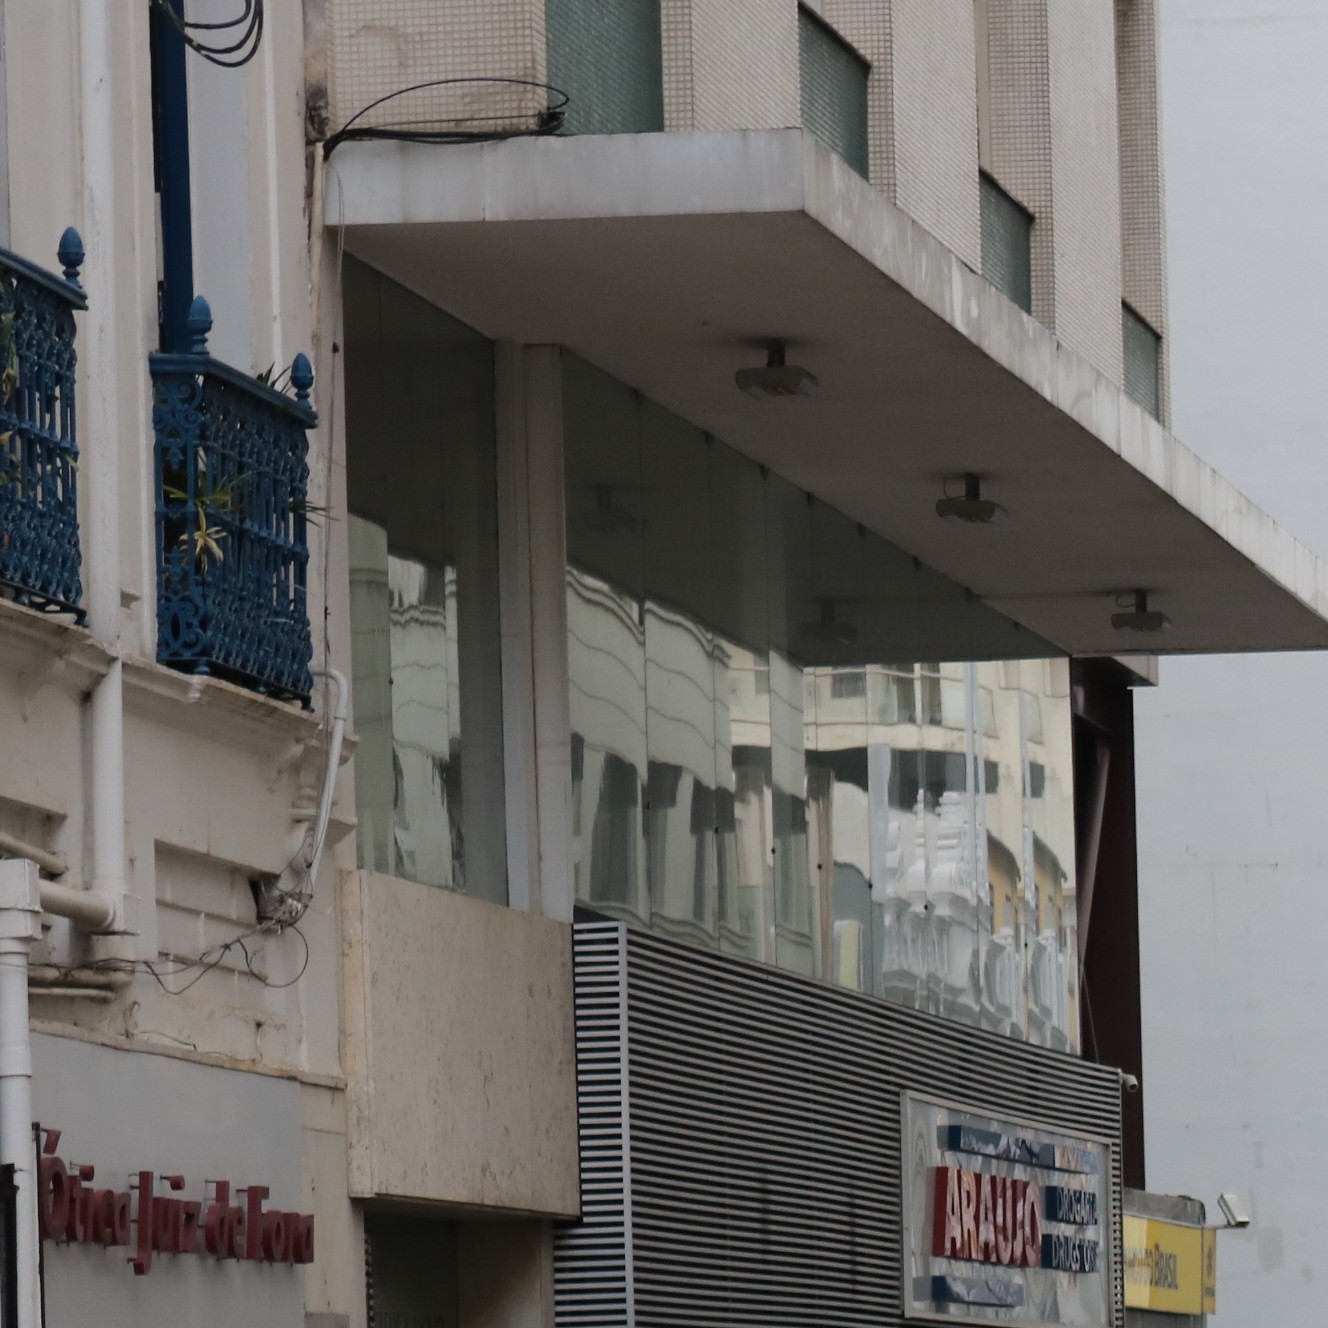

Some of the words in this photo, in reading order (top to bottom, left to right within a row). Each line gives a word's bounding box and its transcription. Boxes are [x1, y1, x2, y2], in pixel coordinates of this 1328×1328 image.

[41, 1129, 131, 1246] Ótica
[132, 1171, 202, 1275] Juiz
[206, 1180, 247, 1259] de
[247, 1186, 314, 1264] Fora
[944, 1166, 1042, 1267] ARAUJO
